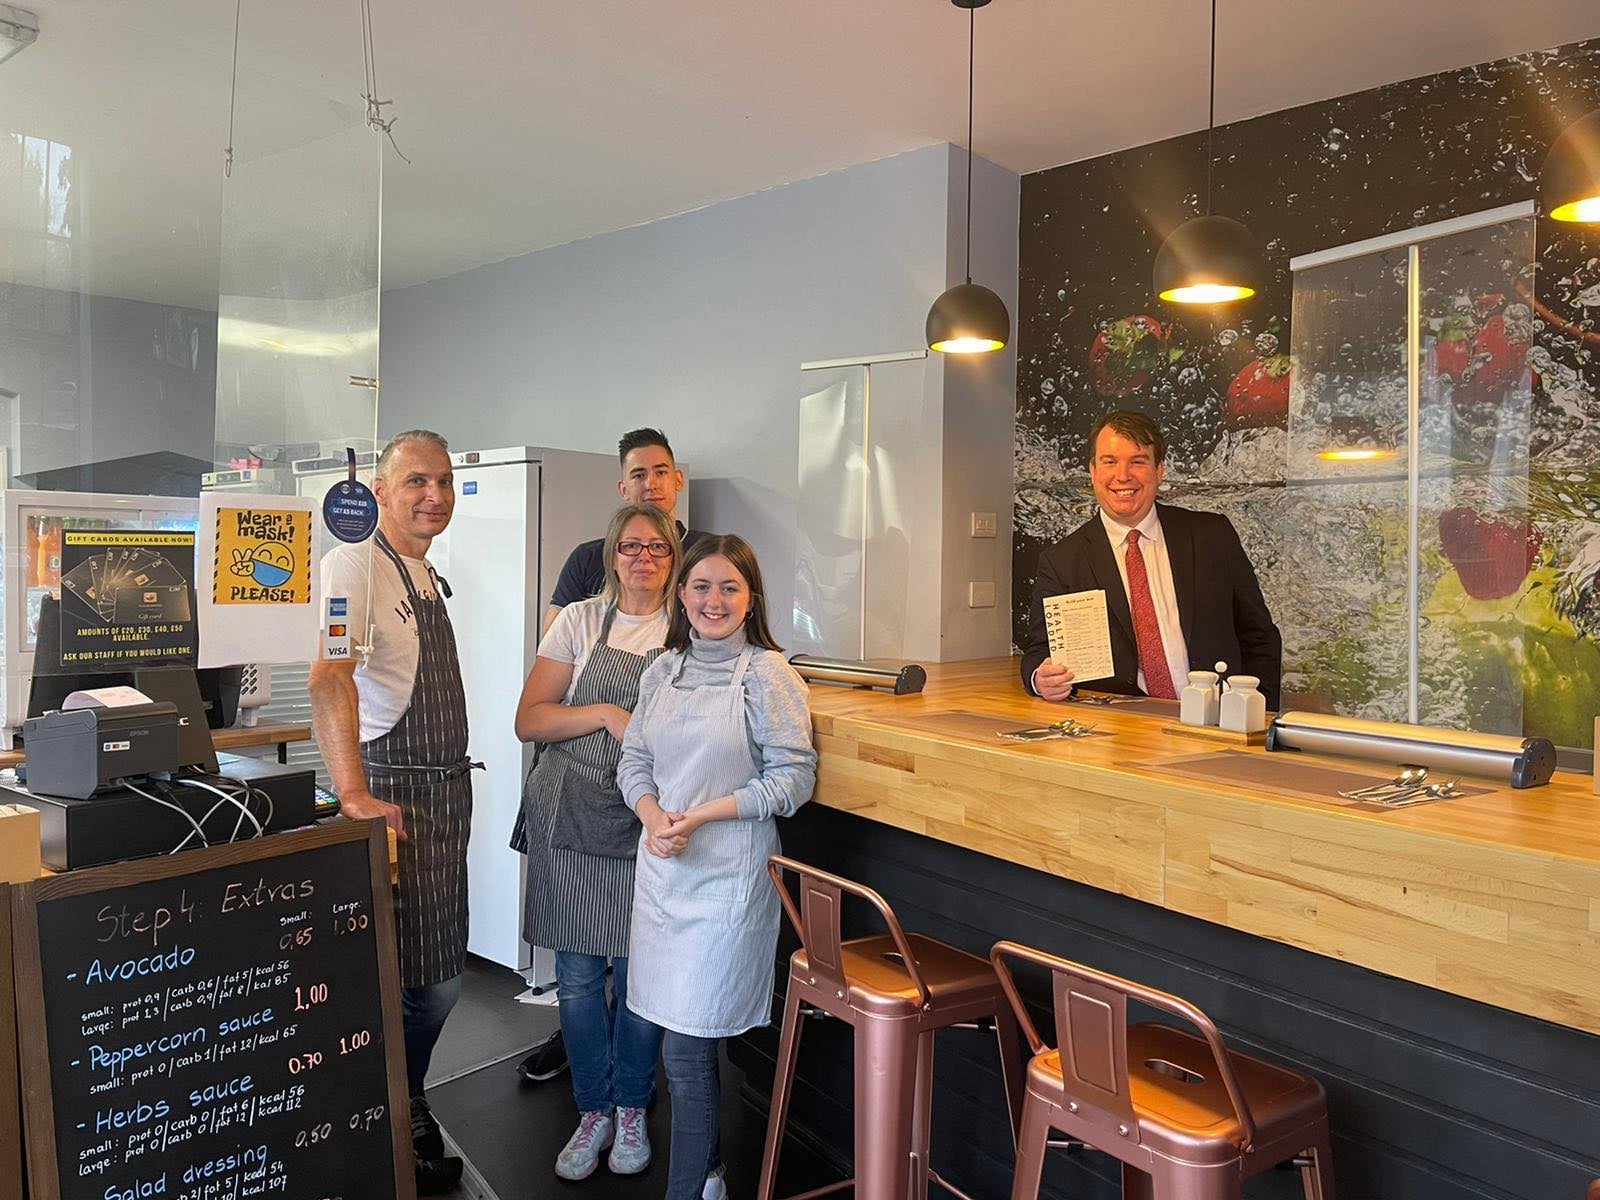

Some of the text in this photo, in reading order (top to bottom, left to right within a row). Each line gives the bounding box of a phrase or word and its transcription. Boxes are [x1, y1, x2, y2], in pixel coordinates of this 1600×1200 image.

[237, 510, 293, 527] Wear a
[237, 524, 295, 543] mask!
[230, 586, 295, 604] PLEASE!
[77, 627, 110, 636] AMOUNTS
[111, 627, 119, 635] OF
[171, 624, 183, 632] £50
[1044, 604, 1058, 652] LOADED
[1052, 603, 1065, 650] HEALTH
[63, 652, 77, 660] ASK
[79, 651, 93, 660] OUR
[94, 650, 115, 659] STAFF
[116, 650, 124, 658] IF
[125, 649, 138, 657] YOU
[140, 648, 161, 657] WOULD
[163, 647, 177, 655] LIKE
[328, 647, 347, 656] VISA
[129, 729, 149, 737] EPSON
[97, 877, 315, 948] Step 4: Extras
[86, 944, 196, 986] Avocado
[81, 1006, 115, 1022] small:
[122, 998, 142, 1014] prot
[144, 992, 161, 1004] 0,9
[171, 983, 195, 998] carb
[197, 978, 214, 991] 0,6
[223, 971, 240, 989] fat
[241, 970, 250, 980] 5
[256, 963, 275, 976] kcal
[277, 959, 291, 971] 56
[122, 1011, 140, 1030] prot
[170, 998, 193, 1012] carb
[196, 992, 213, 1005] 0,9
[218, 988, 233, 1005] fat
[237, 984, 245, 995] 8
[253, 978, 272, 991] kal
[274, 973, 292, 987] 85
[88, 1026, 206, 1079] Peppercorn
[218, 1007, 275, 1037] sauce
[89, 1077, 125, 1095] small:
[131, 1064, 154, 1086] prot
[157, 1062, 167, 1073] 0
[176, 1052, 202, 1068] carb
[203, 1047, 211, 1061] 1
[219, 1042, 237, 1062] fat
[239, 1036, 252, 1051] 12
[258, 1029, 279, 1046] kcal
[282, 1024, 299, 1039] 65
[288, 1029, 371, 1075] 0.70 1.00
[96, 1099, 170, 1135] Herbs
[189, 1074, 255, 1107] sauce
[128, 1127, 152, 1149] prot
[154, 1124, 164, 1137] 0
[170, 1113, 198, 1132] carb
[201, 1110, 210, 1122] 0
[219, 1103, 238, 1122] fat
[241, 1100, 249, 1111] 6
[258, 1089, 286, 1106] kcal
[287, 1084, 306, 1098] 56
[125, 1143, 145, 1164] prot
[149, 1138, 160, 1151] 0
[167, 1128, 193, 1145] carb
[197, 1123, 207, 1135] 0
[215, 1117, 231, 1134] fat
[235, 1113, 247, 1123] 12
[258, 1102, 283, 1117] kcal
[285, 1098, 303, 1111] 112
[103, 1142, 268, 1200] Salad dressing
[203, 1182, 221, 1200] fat
[224, 1176, 233, 1190] 5
[243, 1167, 267, 1183] kcal
[270, 1160, 284, 1175] 54
[242, 1182, 266, 1198] kcal
[269, 1174, 289, 1192] 107
